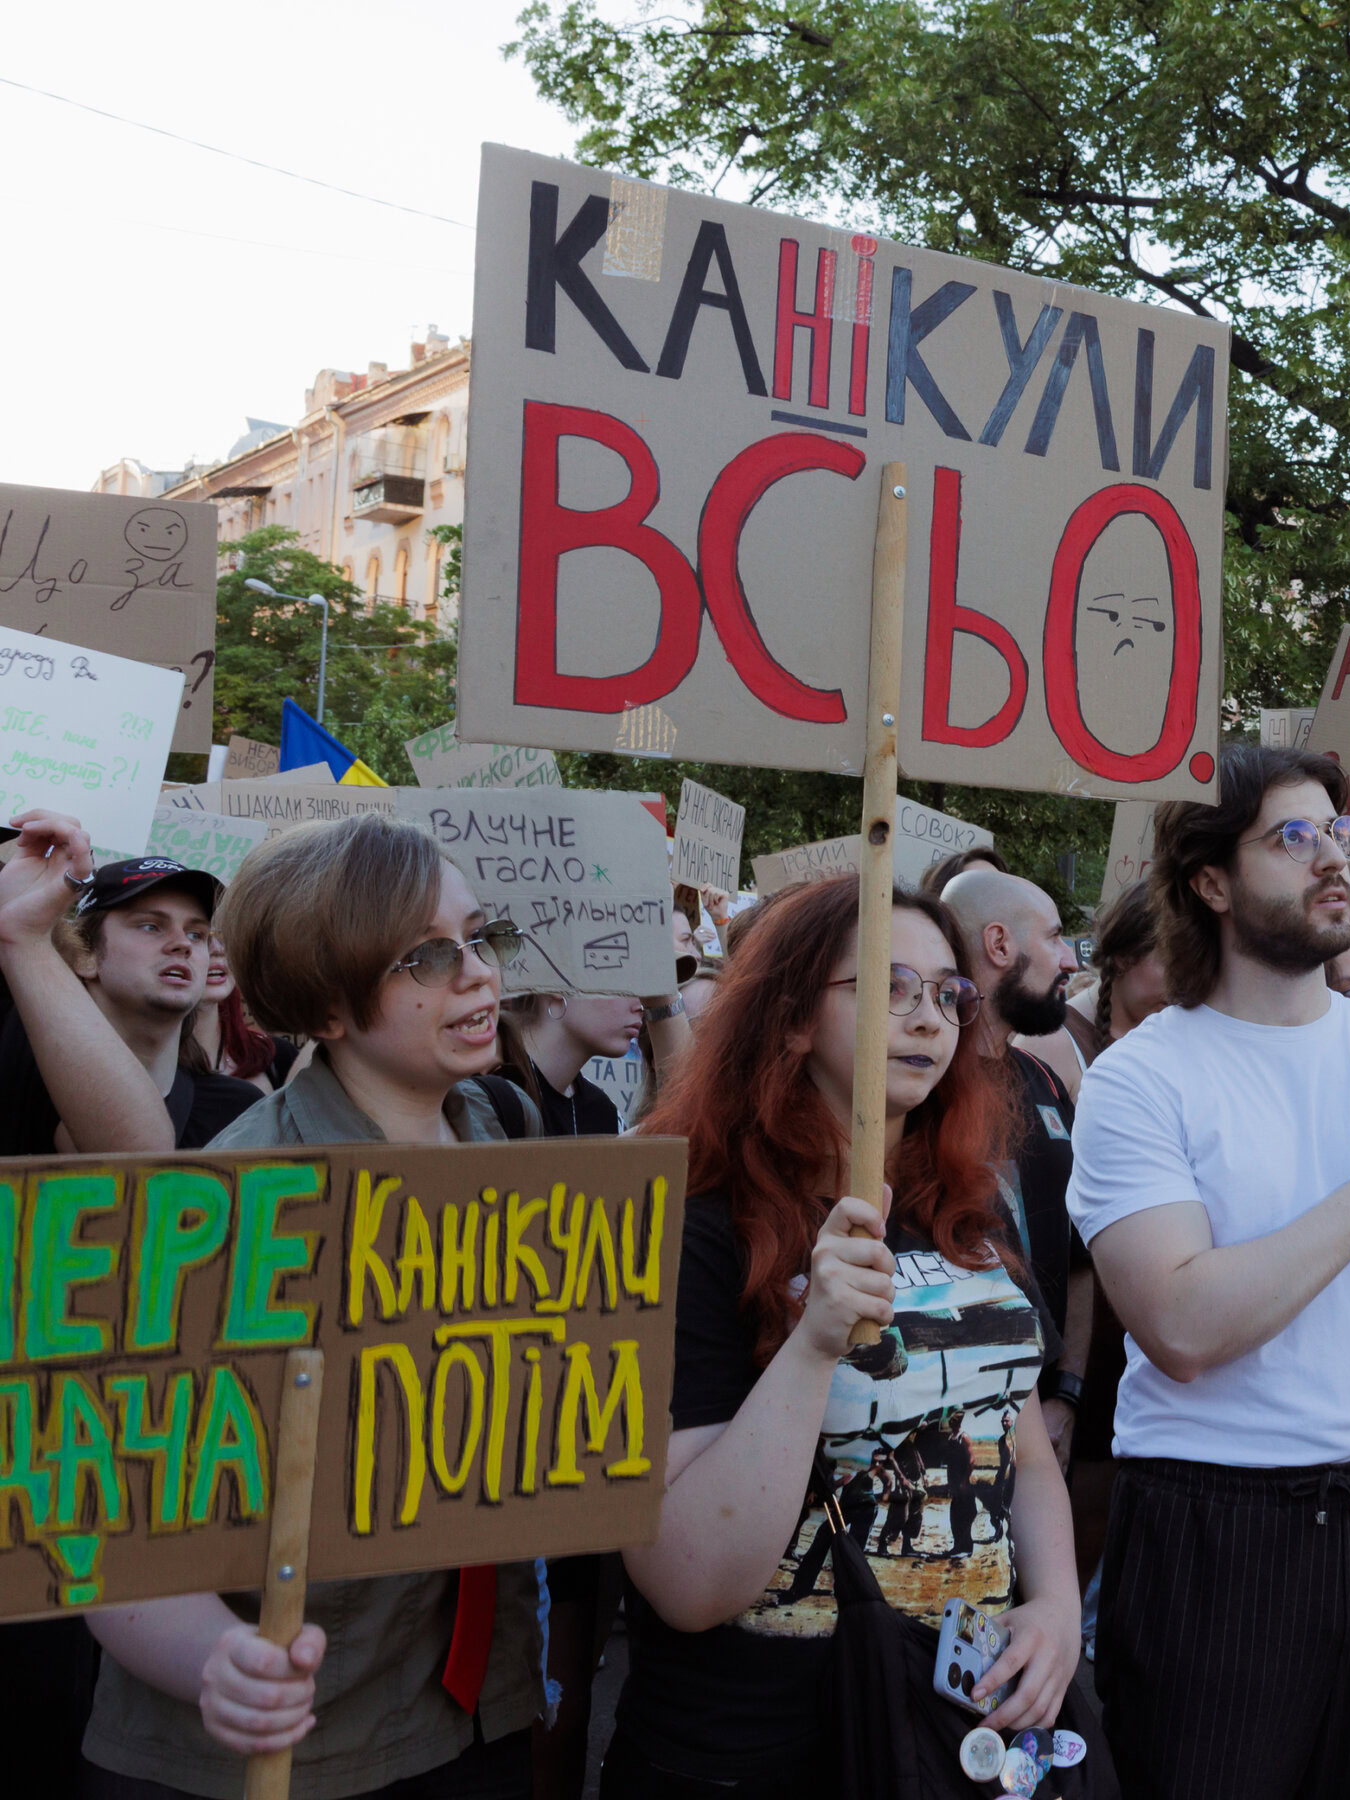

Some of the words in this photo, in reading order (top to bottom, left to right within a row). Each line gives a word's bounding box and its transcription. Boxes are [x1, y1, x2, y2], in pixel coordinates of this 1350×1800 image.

[525, 180, 1216, 490] КАНІКУЛИ
[429, 808, 577, 848] ВЛУЧНЕ
[901, 806, 977, 850] СОВОК?
[138, 859, 185, 873] For
[348, 1316, 652, 1535] ПОТІМ
